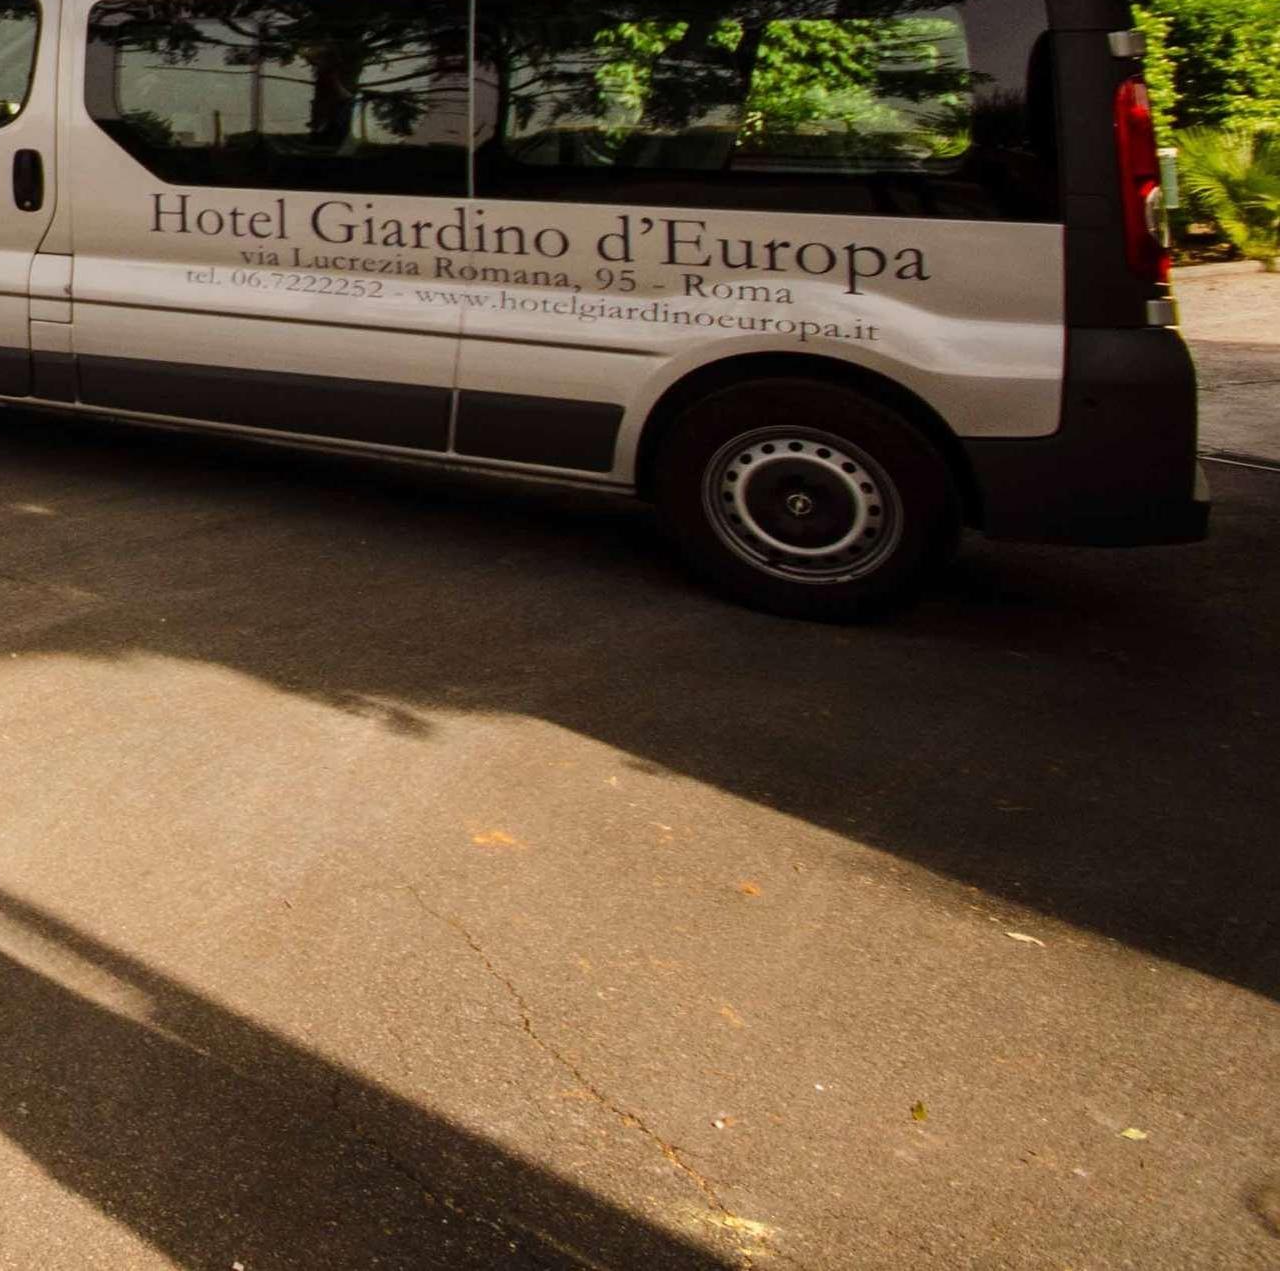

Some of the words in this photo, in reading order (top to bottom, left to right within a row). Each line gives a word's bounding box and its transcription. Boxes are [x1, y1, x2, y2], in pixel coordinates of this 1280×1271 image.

[151, 193, 288, 240] Hotel
[311, 200, 569, 258] Giardino
[597, 215, 932, 296] d'Europa
[240, 245, 280, 267] via
[292, 247, 421, 276] Lucrezia
[435, 256, 582, 293] Romana,
[595, 267, 637, 292] 95
[681, 274, 793, 305] Roma
[186, 267, 222, 286] tel.
[231, 271, 384, 298] 06.7222252
[415, 290, 881, 342] www.hotelgiardinoeuropa.it
